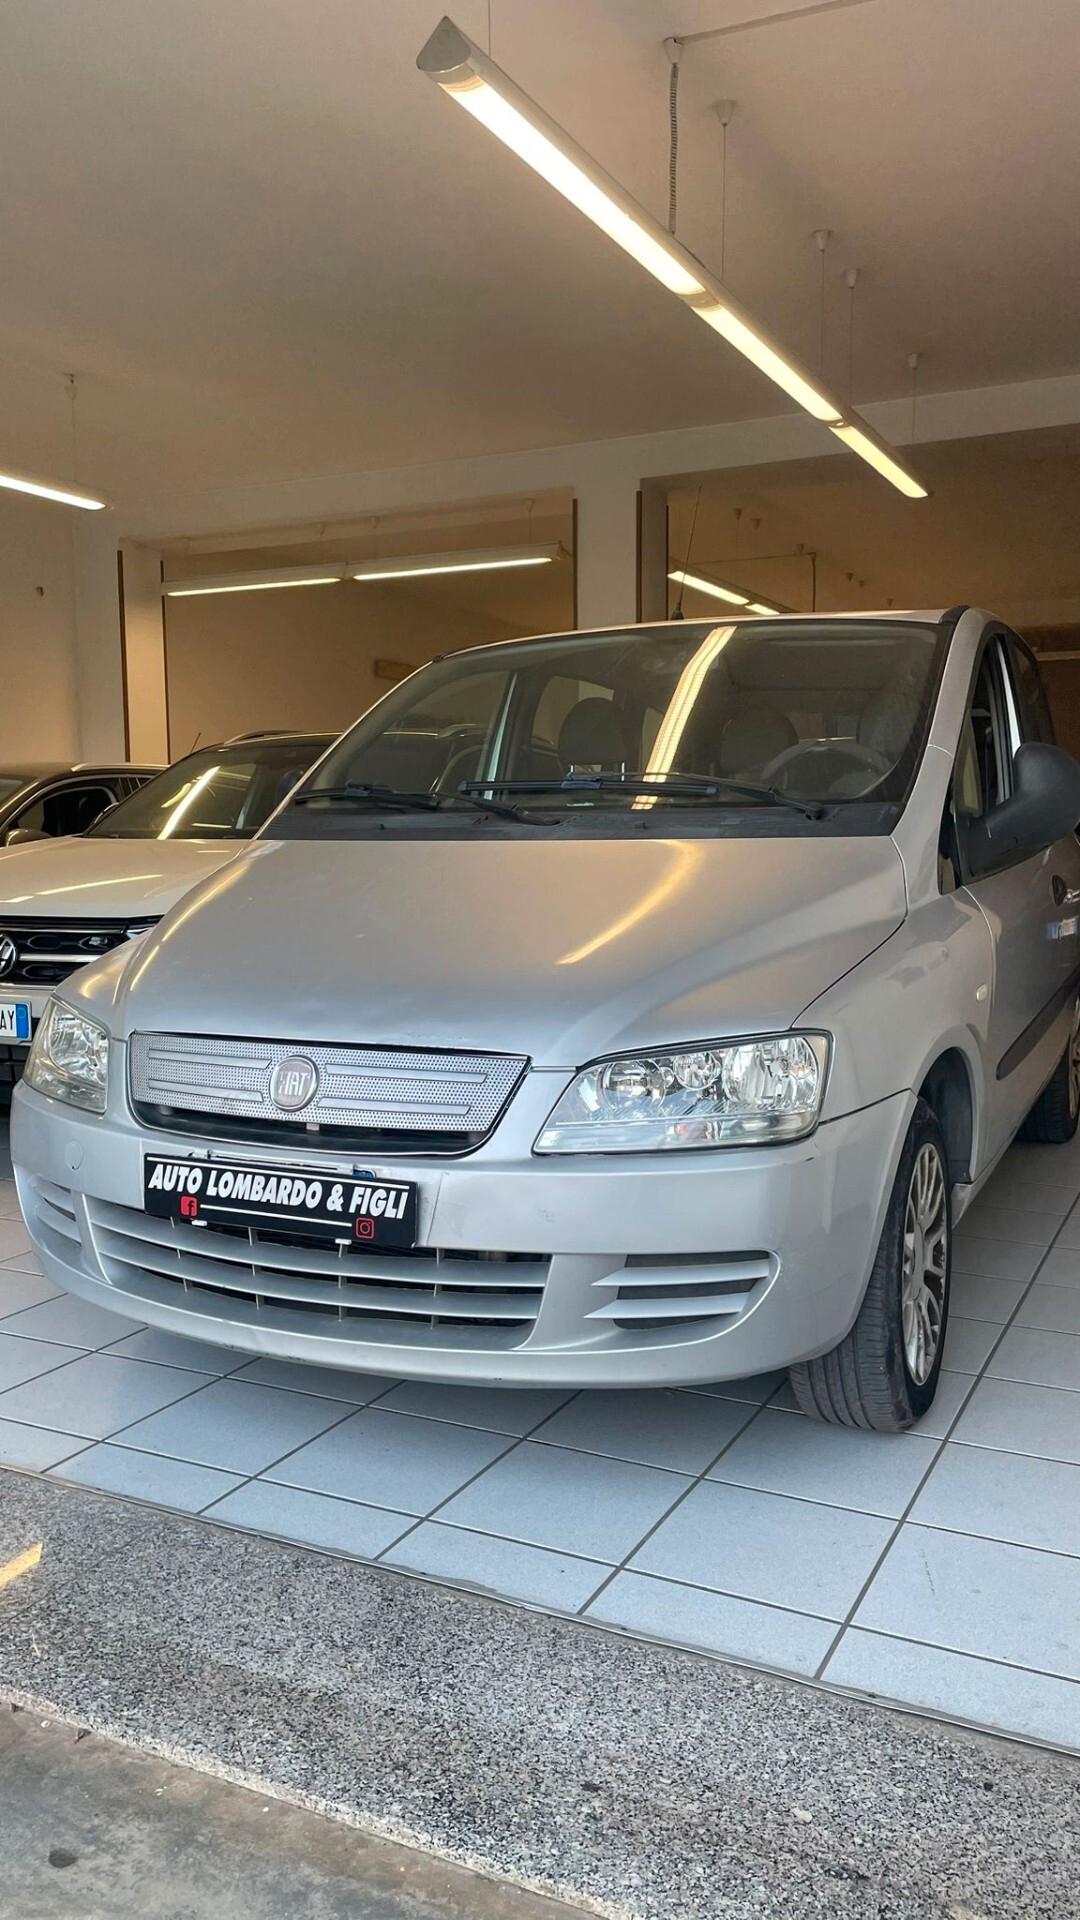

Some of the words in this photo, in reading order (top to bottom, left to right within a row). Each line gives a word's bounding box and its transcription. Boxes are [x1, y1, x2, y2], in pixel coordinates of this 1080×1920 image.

[278, 1071, 309, 1096] FIAT
[149, 1164, 203, 1194] AUTO
[206, 1170, 323, 1209] LOMBARDO
[326, 1183, 344, 1212] &
[348, 1186, 409, 1219] FIGLI
